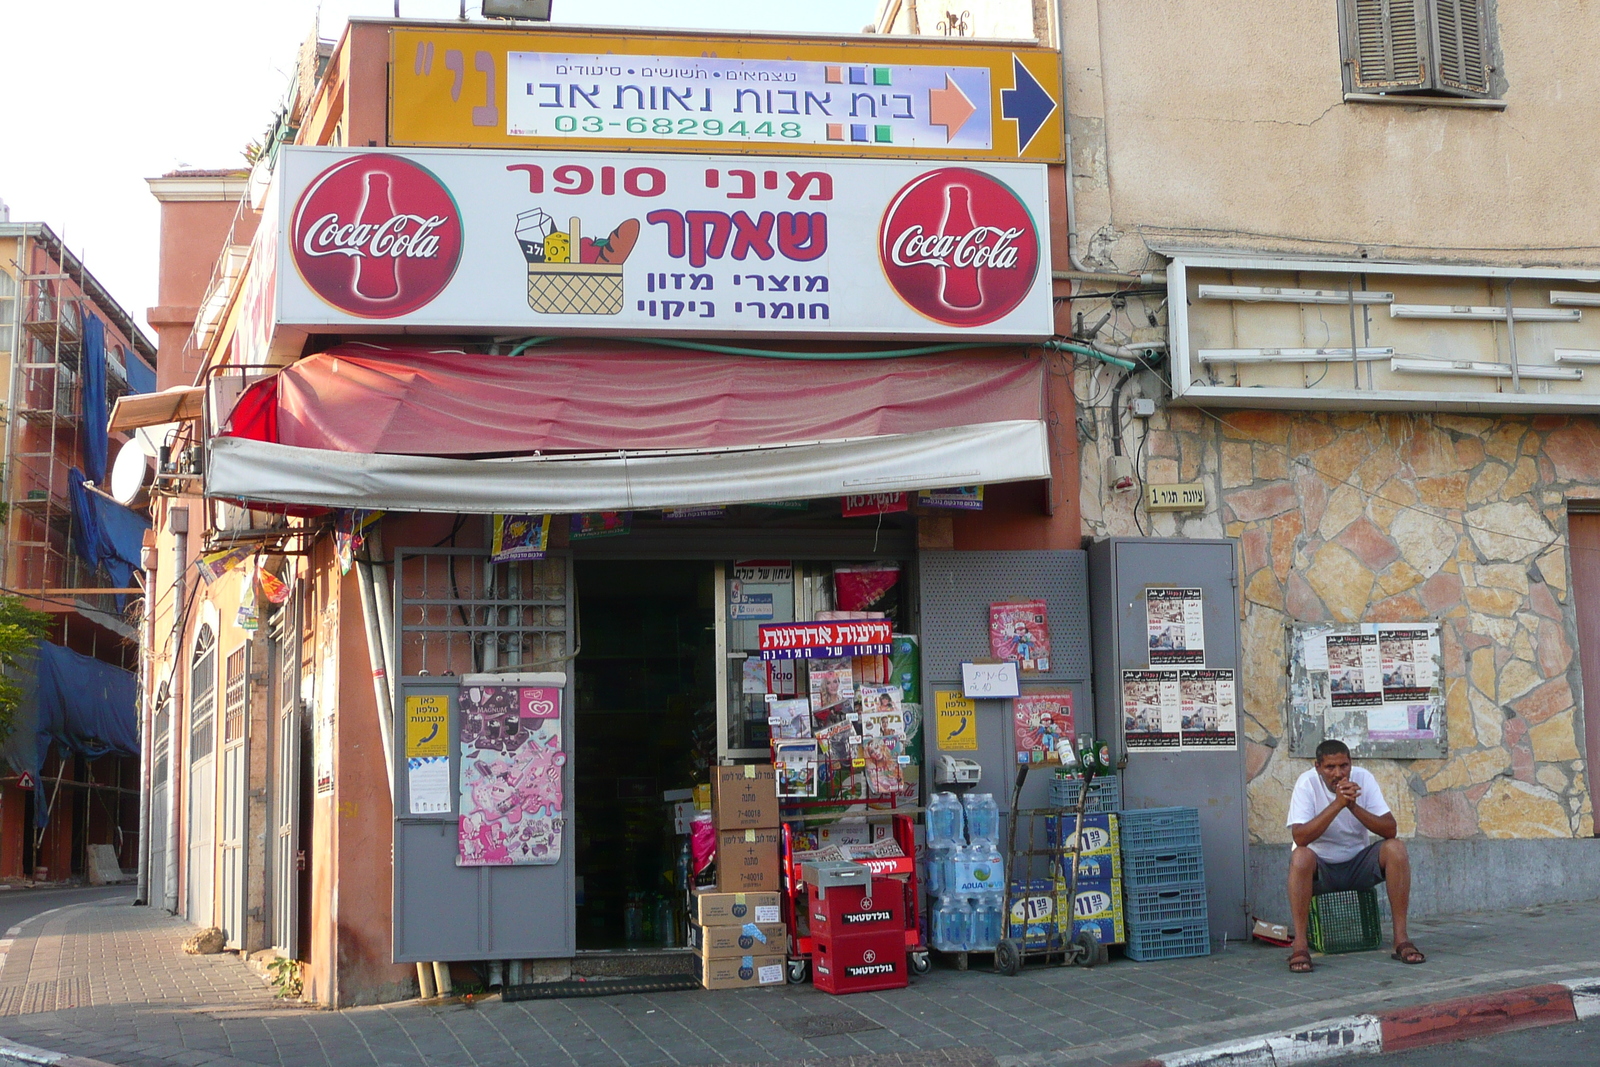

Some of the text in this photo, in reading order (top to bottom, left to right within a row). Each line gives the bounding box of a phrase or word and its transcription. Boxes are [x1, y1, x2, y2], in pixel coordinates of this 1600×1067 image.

[556, 65, 797, 82] עצמאים תשושים סיעודים
[526, 82, 915, 119] בית אבות נאות אבי
[554, 115, 802, 138] 03-6829448
[506, 163, 834, 201] מיני סופר
[303, 213, 448, 258] Coca-Cola
[646, 208, 828, 268] שאקר
[892, 224, 1025, 268] Coca-Cola
[648, 273, 829, 292] מוצרי מזון
[637, 300, 830, 320] חומרי ניקוי
[846, 494, 865, 511] כאן
[1152, 488, 1158, 504] 1
[735, 567, 791, 581] עיתון של כולם
[763, 623, 890, 647] ידיעות אחרונות
[763, 643, 891, 660] העיתון של המדינה
[420, 697, 435, 705] כאן
[946, 700, 967, 709] טלפון
[949, 692, 962, 700] כאן
[416, 705, 439, 714] טלפון
[870, 715, 902, 724] בלזר
[864, 860, 897, 873] ידיעו
[847, 911, 890, 923] גולדסטאר
[850, 963, 893, 976] גולדסטאר
